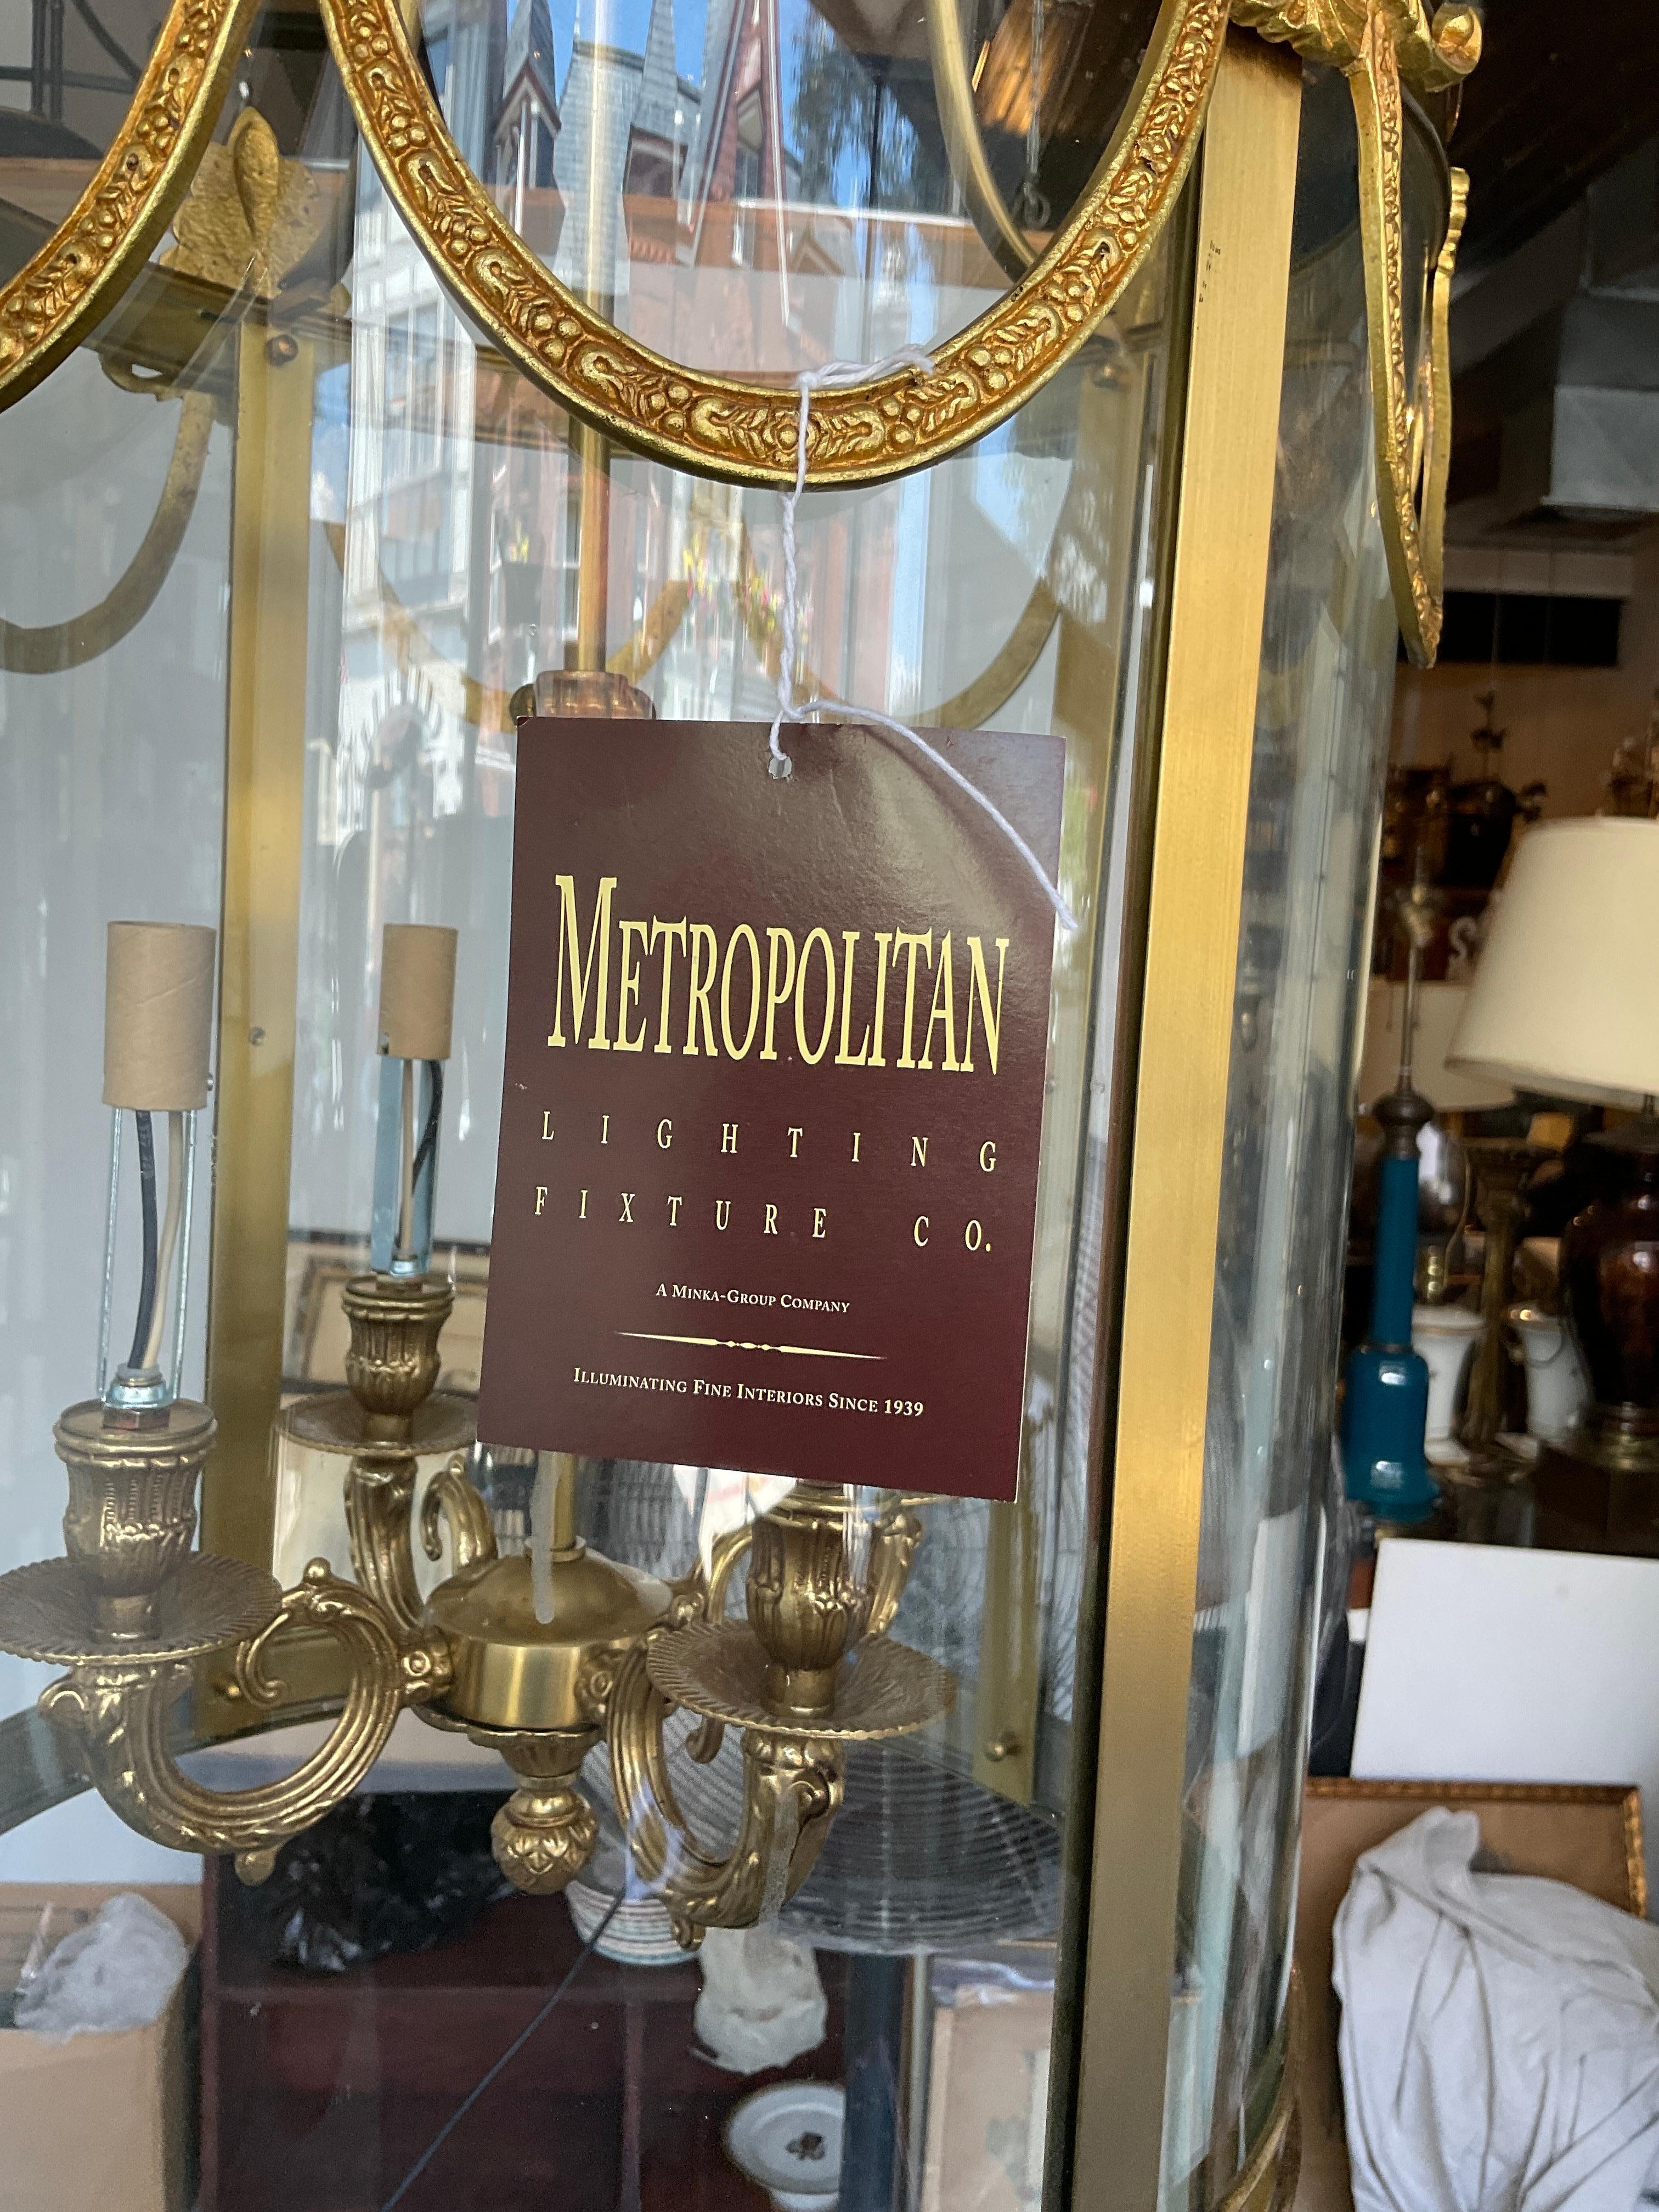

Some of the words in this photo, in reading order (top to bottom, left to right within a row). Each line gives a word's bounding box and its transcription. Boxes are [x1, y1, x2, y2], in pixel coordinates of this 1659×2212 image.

[548, 874, 1010, 1075] METROPOLITAN
[914, 1216, 991, 1252] CO.
[656, 1283, 668, 1296] A
[780, 1294, 850, 1313] COMPANY
[573, 1367, 687, 1393] ILLUMINATING
[693, 1379, 731, 1397] FINE
[737, 1383, 822, 1407] INTERIORS
[828, 1392, 878, 1412] SINCE
[884, 1400, 923, 1417] 1939
